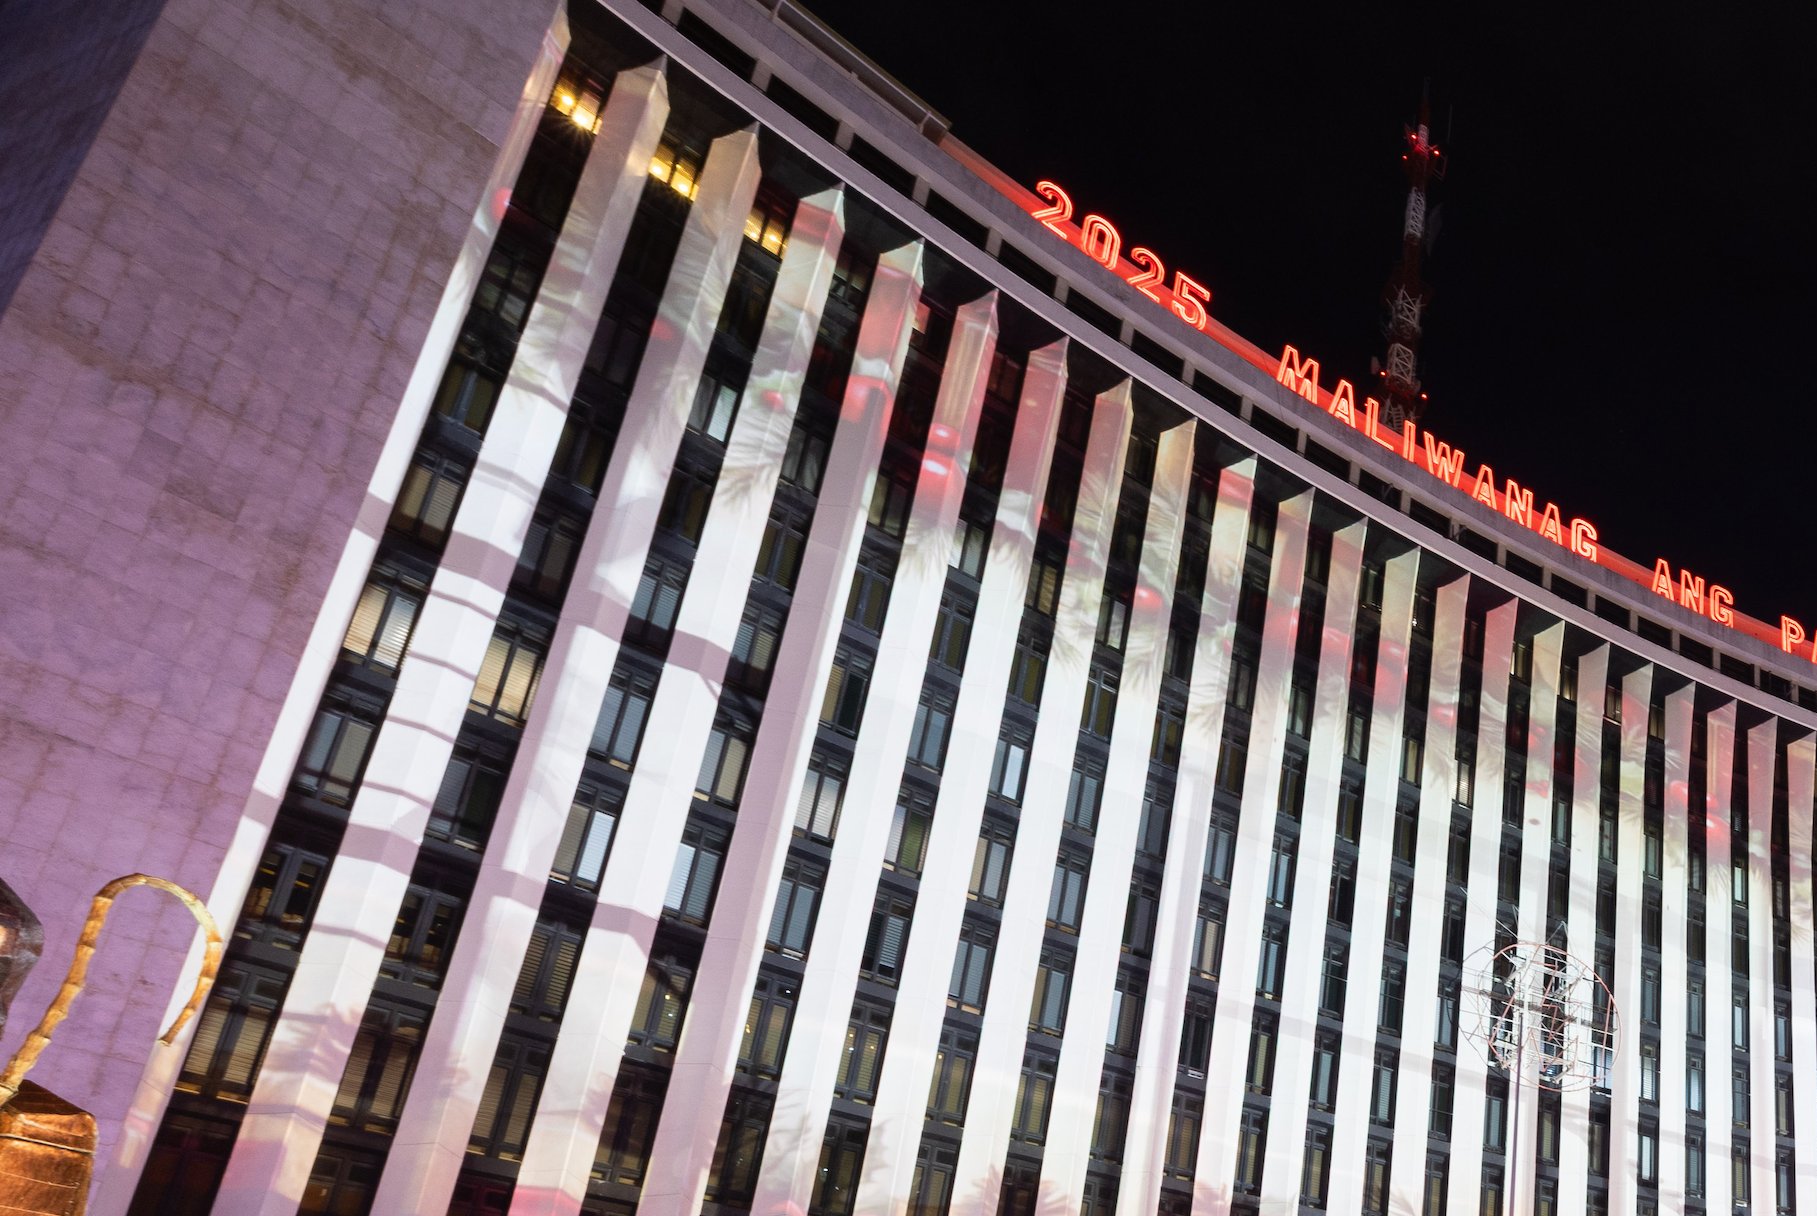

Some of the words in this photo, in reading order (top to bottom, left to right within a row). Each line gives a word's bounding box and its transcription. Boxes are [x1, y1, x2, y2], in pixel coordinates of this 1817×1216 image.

[1031, 180, 1210, 331] 2025
[1276, 344, 1598, 562] MALIWANAG
[1651, 558, 1734, 628] ANG
